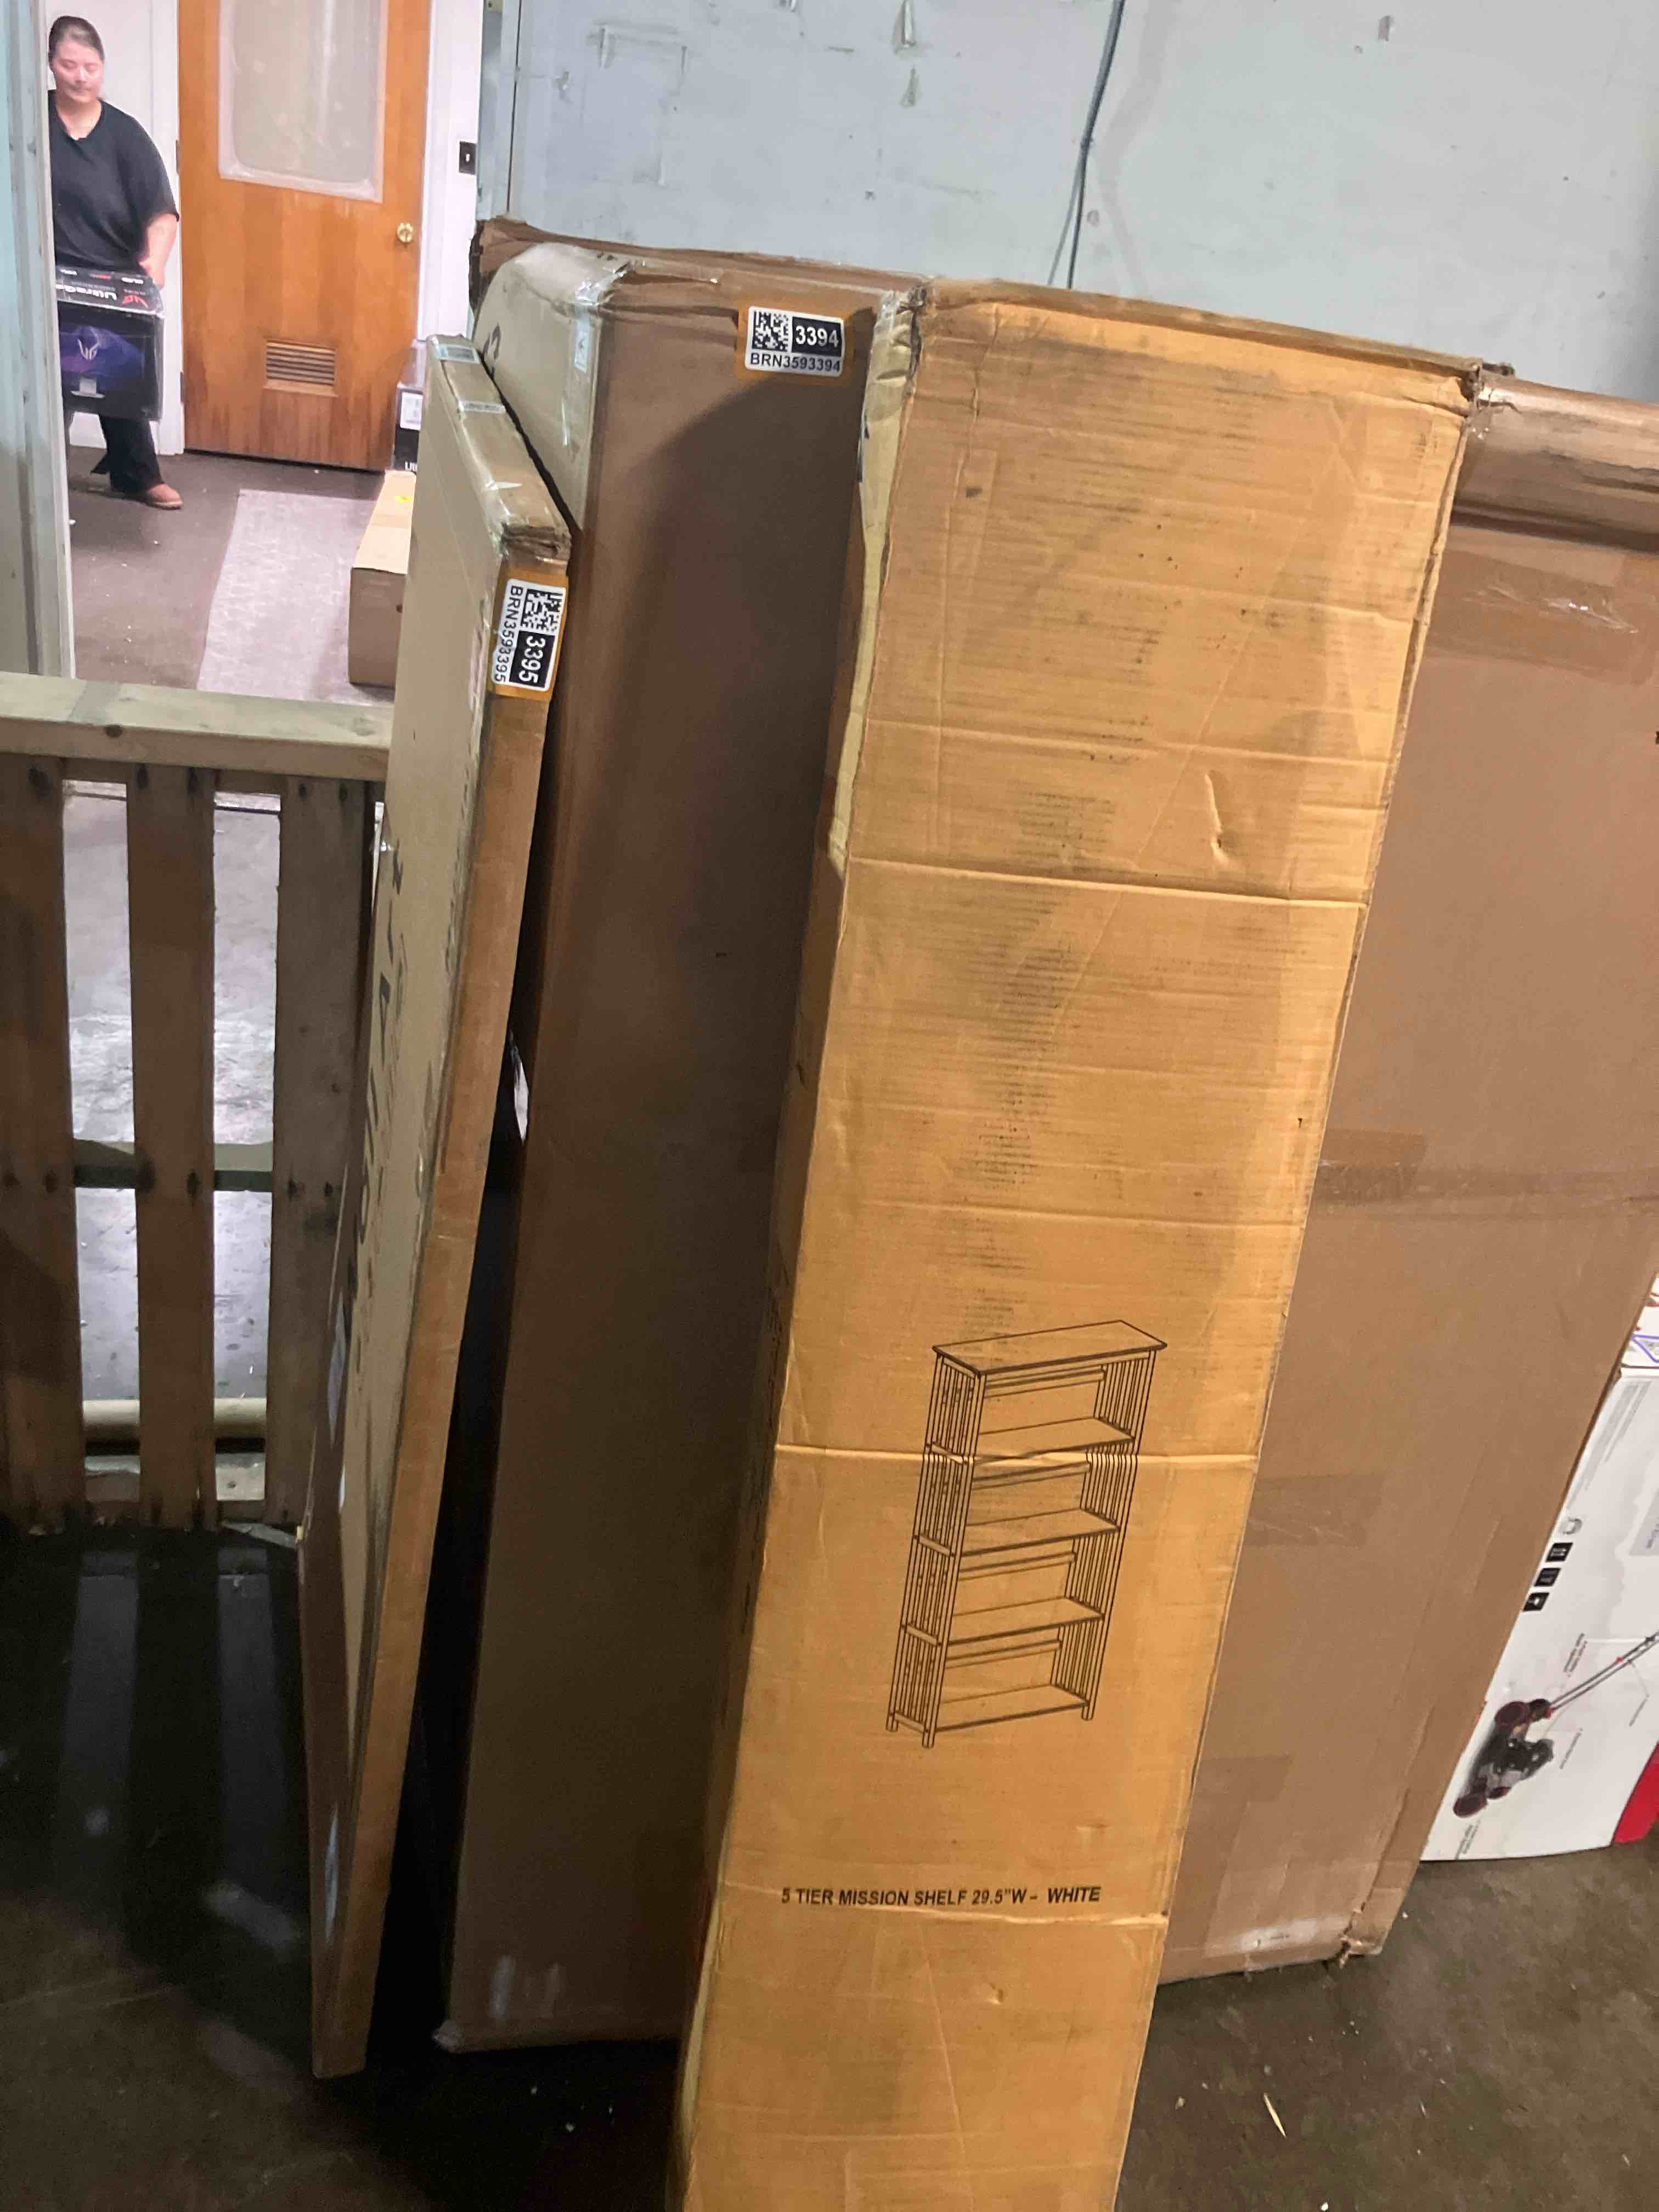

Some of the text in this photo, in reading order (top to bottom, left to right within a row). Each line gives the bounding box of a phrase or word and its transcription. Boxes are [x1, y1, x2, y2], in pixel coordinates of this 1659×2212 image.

[795, 325, 839, 348] 3394
[750, 352, 841, 373] BRN3593394
[495, 585, 523, 682] BRN3593395
[518, 636, 545, 684] 3395
[782, 1888, 791, 1904] 5
[794, 1888, 834, 1905] TIER
[838, 1889, 909, 1905] MISSION
[913, 1889, 968, 1905] SHELF
[1047, 1886, 1102, 1903] WHITE
